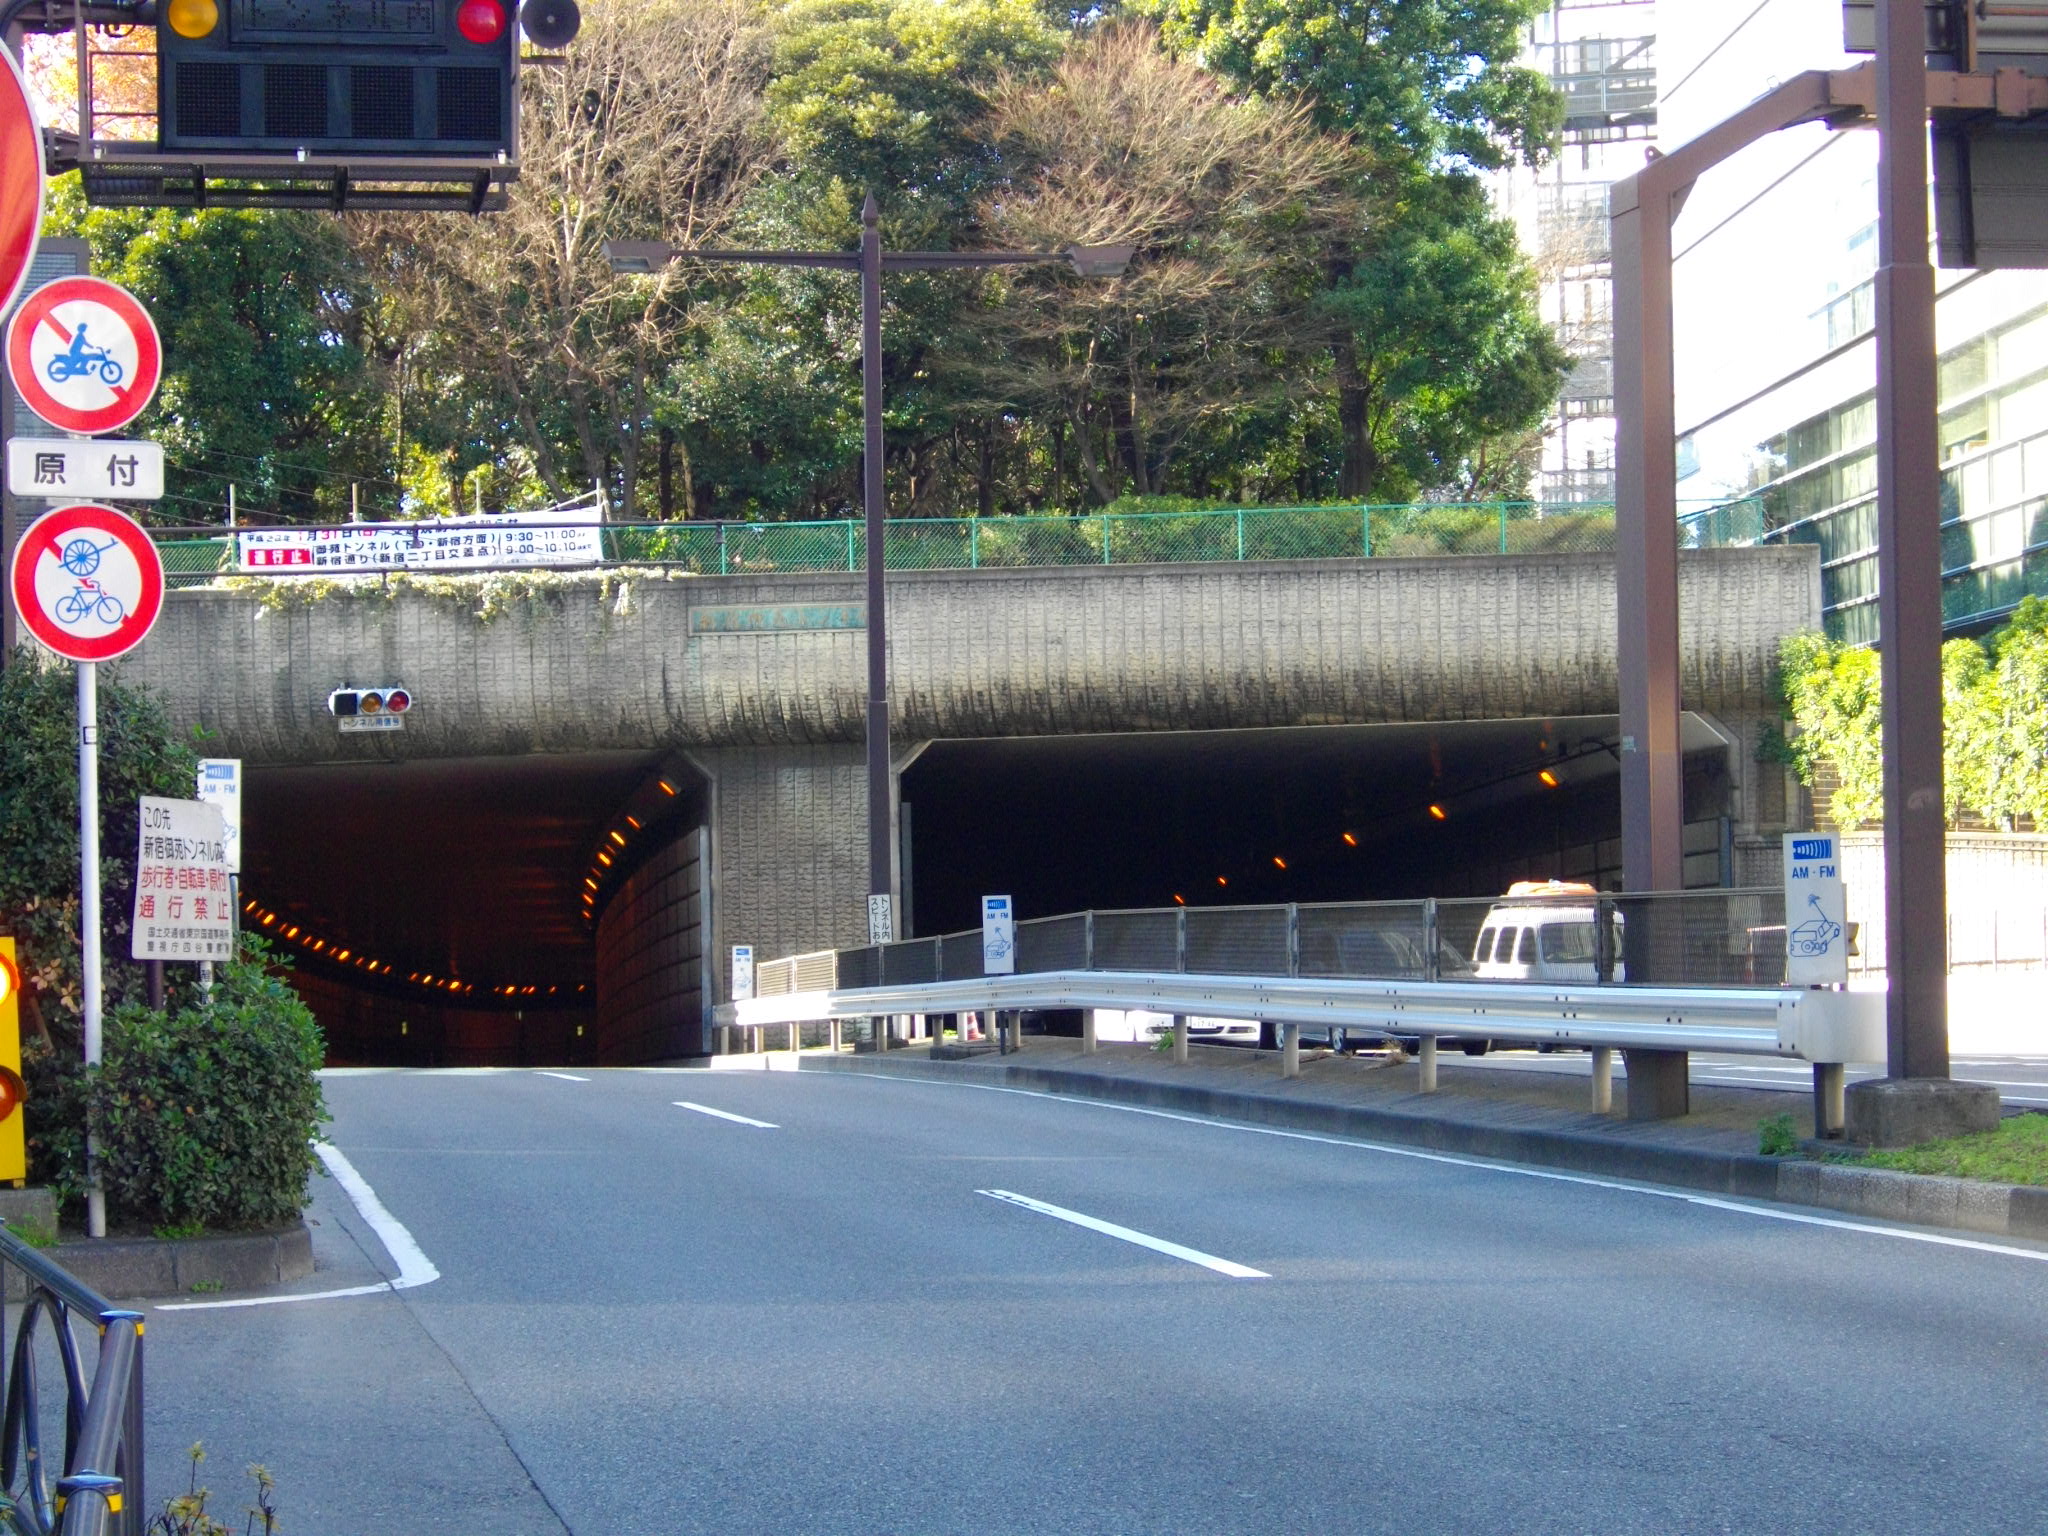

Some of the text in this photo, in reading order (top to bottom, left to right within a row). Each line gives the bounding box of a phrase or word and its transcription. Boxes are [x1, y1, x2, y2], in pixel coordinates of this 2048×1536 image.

[34, 452, 139, 487] 原付
[144, 806, 171, 830] この先
[1792, 865, 1835, 879] AM FM
[138, 895, 229, 921] 通行禁止
[880, 896, 891, 940] トンネル内
